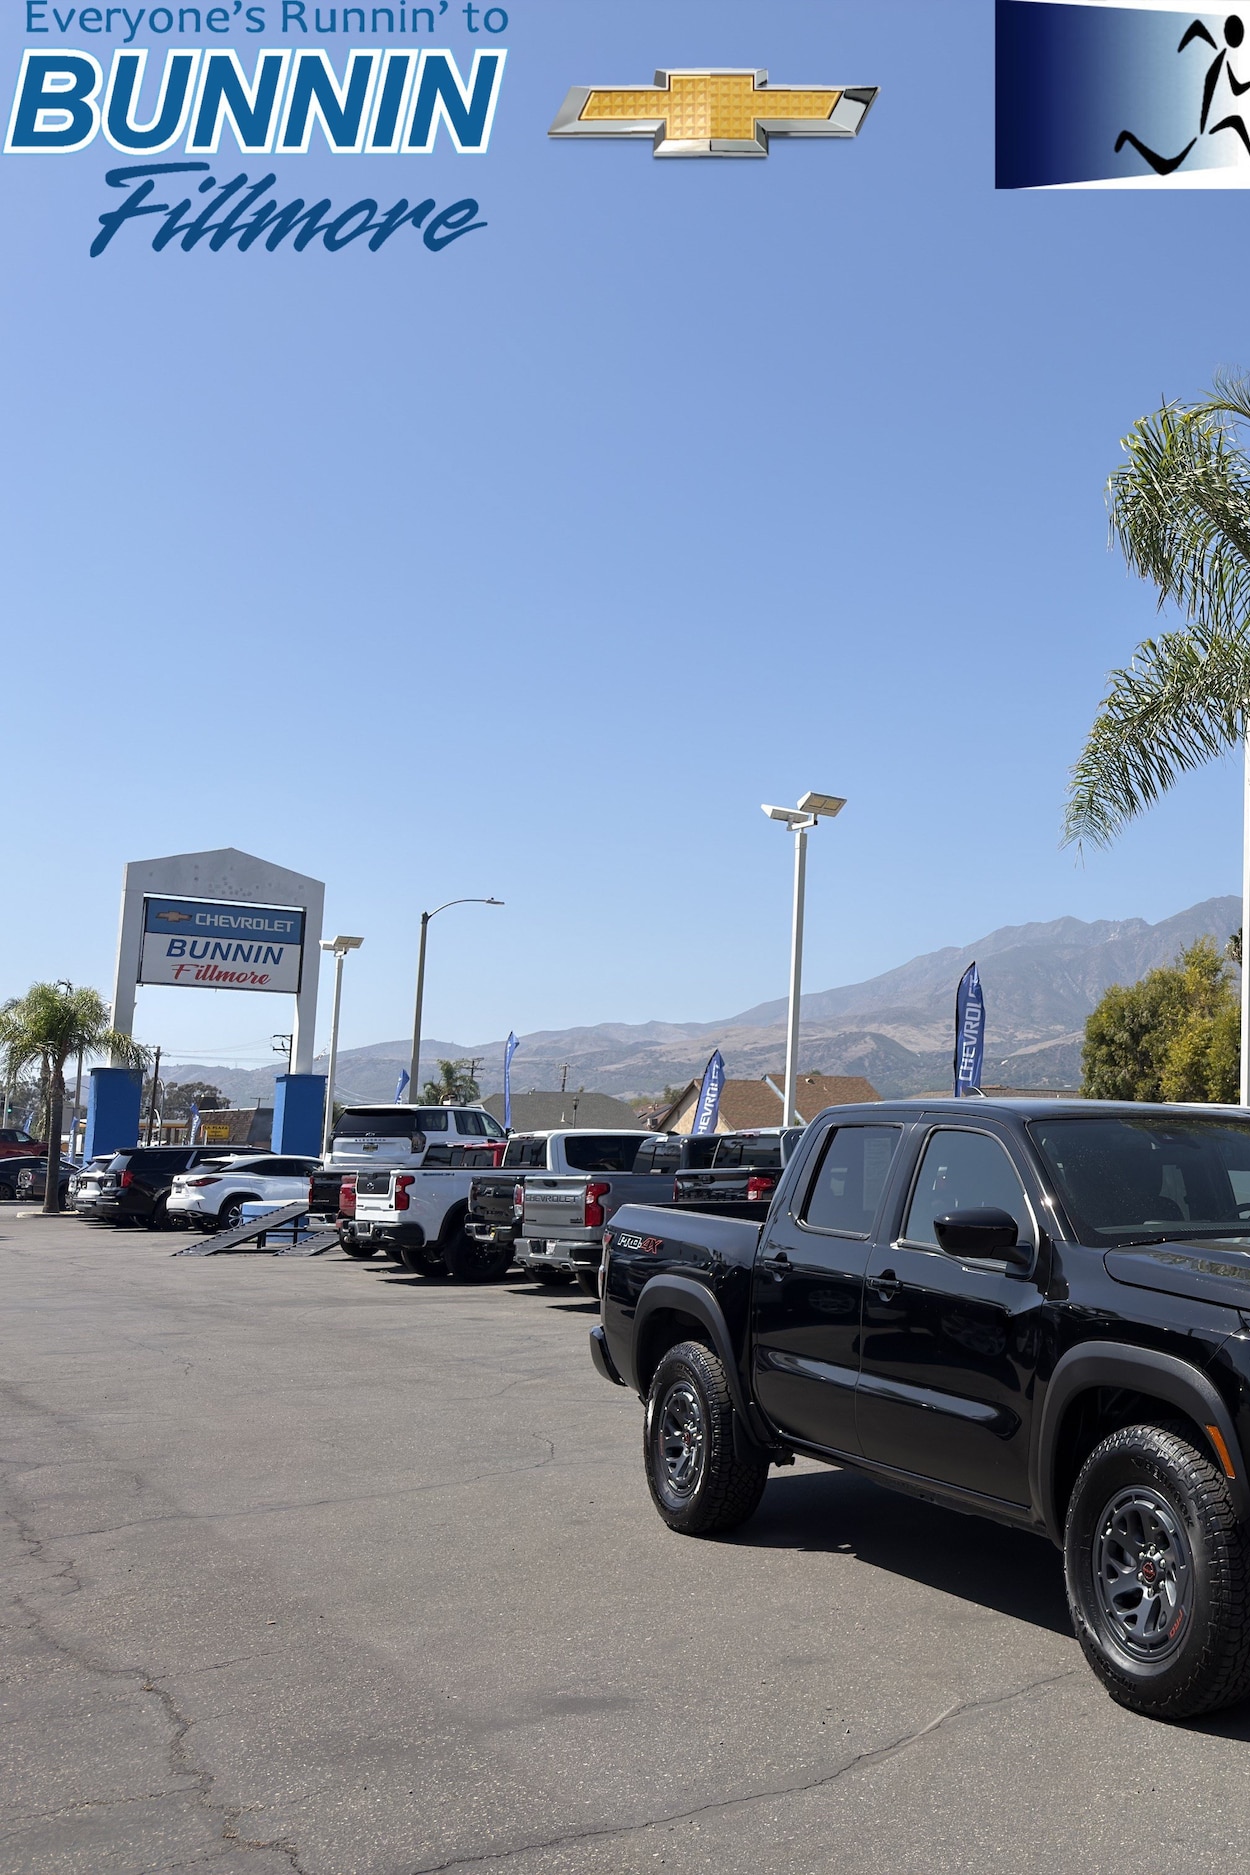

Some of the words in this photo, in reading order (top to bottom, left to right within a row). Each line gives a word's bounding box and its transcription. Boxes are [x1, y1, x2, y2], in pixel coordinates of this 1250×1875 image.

[195, 913, 294, 933] CHEVROLET
[166, 938, 284, 965] BUNNIN
[171, 963, 271, 985] Fillmore
[697, 1060, 721, 1135] HEVRET
